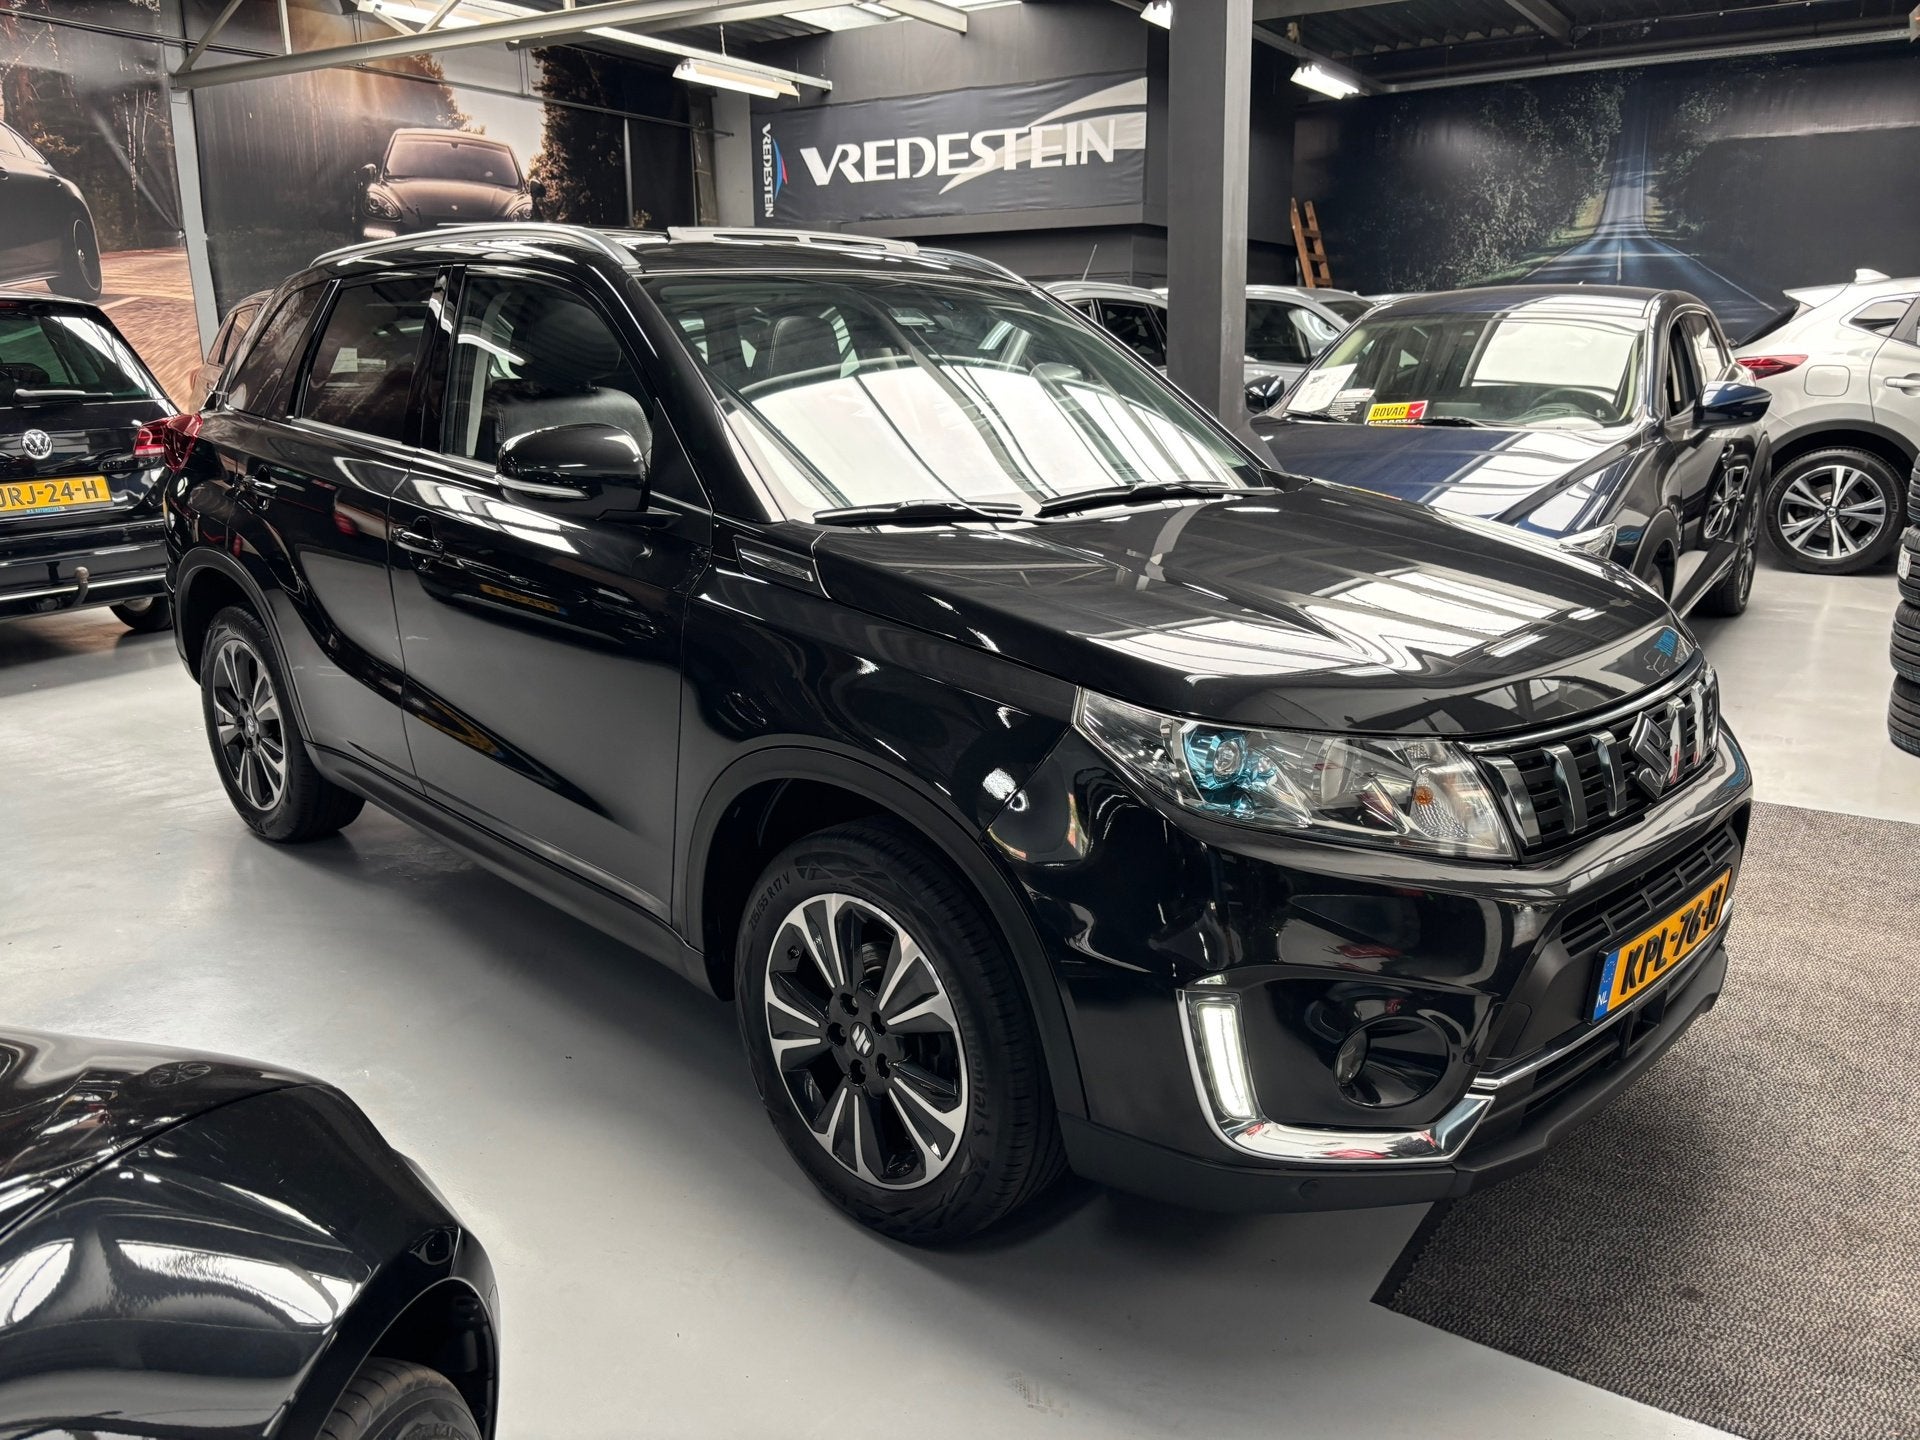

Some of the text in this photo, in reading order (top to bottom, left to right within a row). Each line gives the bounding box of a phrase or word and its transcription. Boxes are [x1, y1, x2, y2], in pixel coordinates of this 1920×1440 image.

[762, 122, 774, 217] VREDESTEIN
[800, 119, 1116, 186] VREDESTEIN
[1372, 406, 1406, 417] BOVAG
[1620, 883, 1723, 996] KPL-76-H
[1596, 990, 1608, 1008] NL
